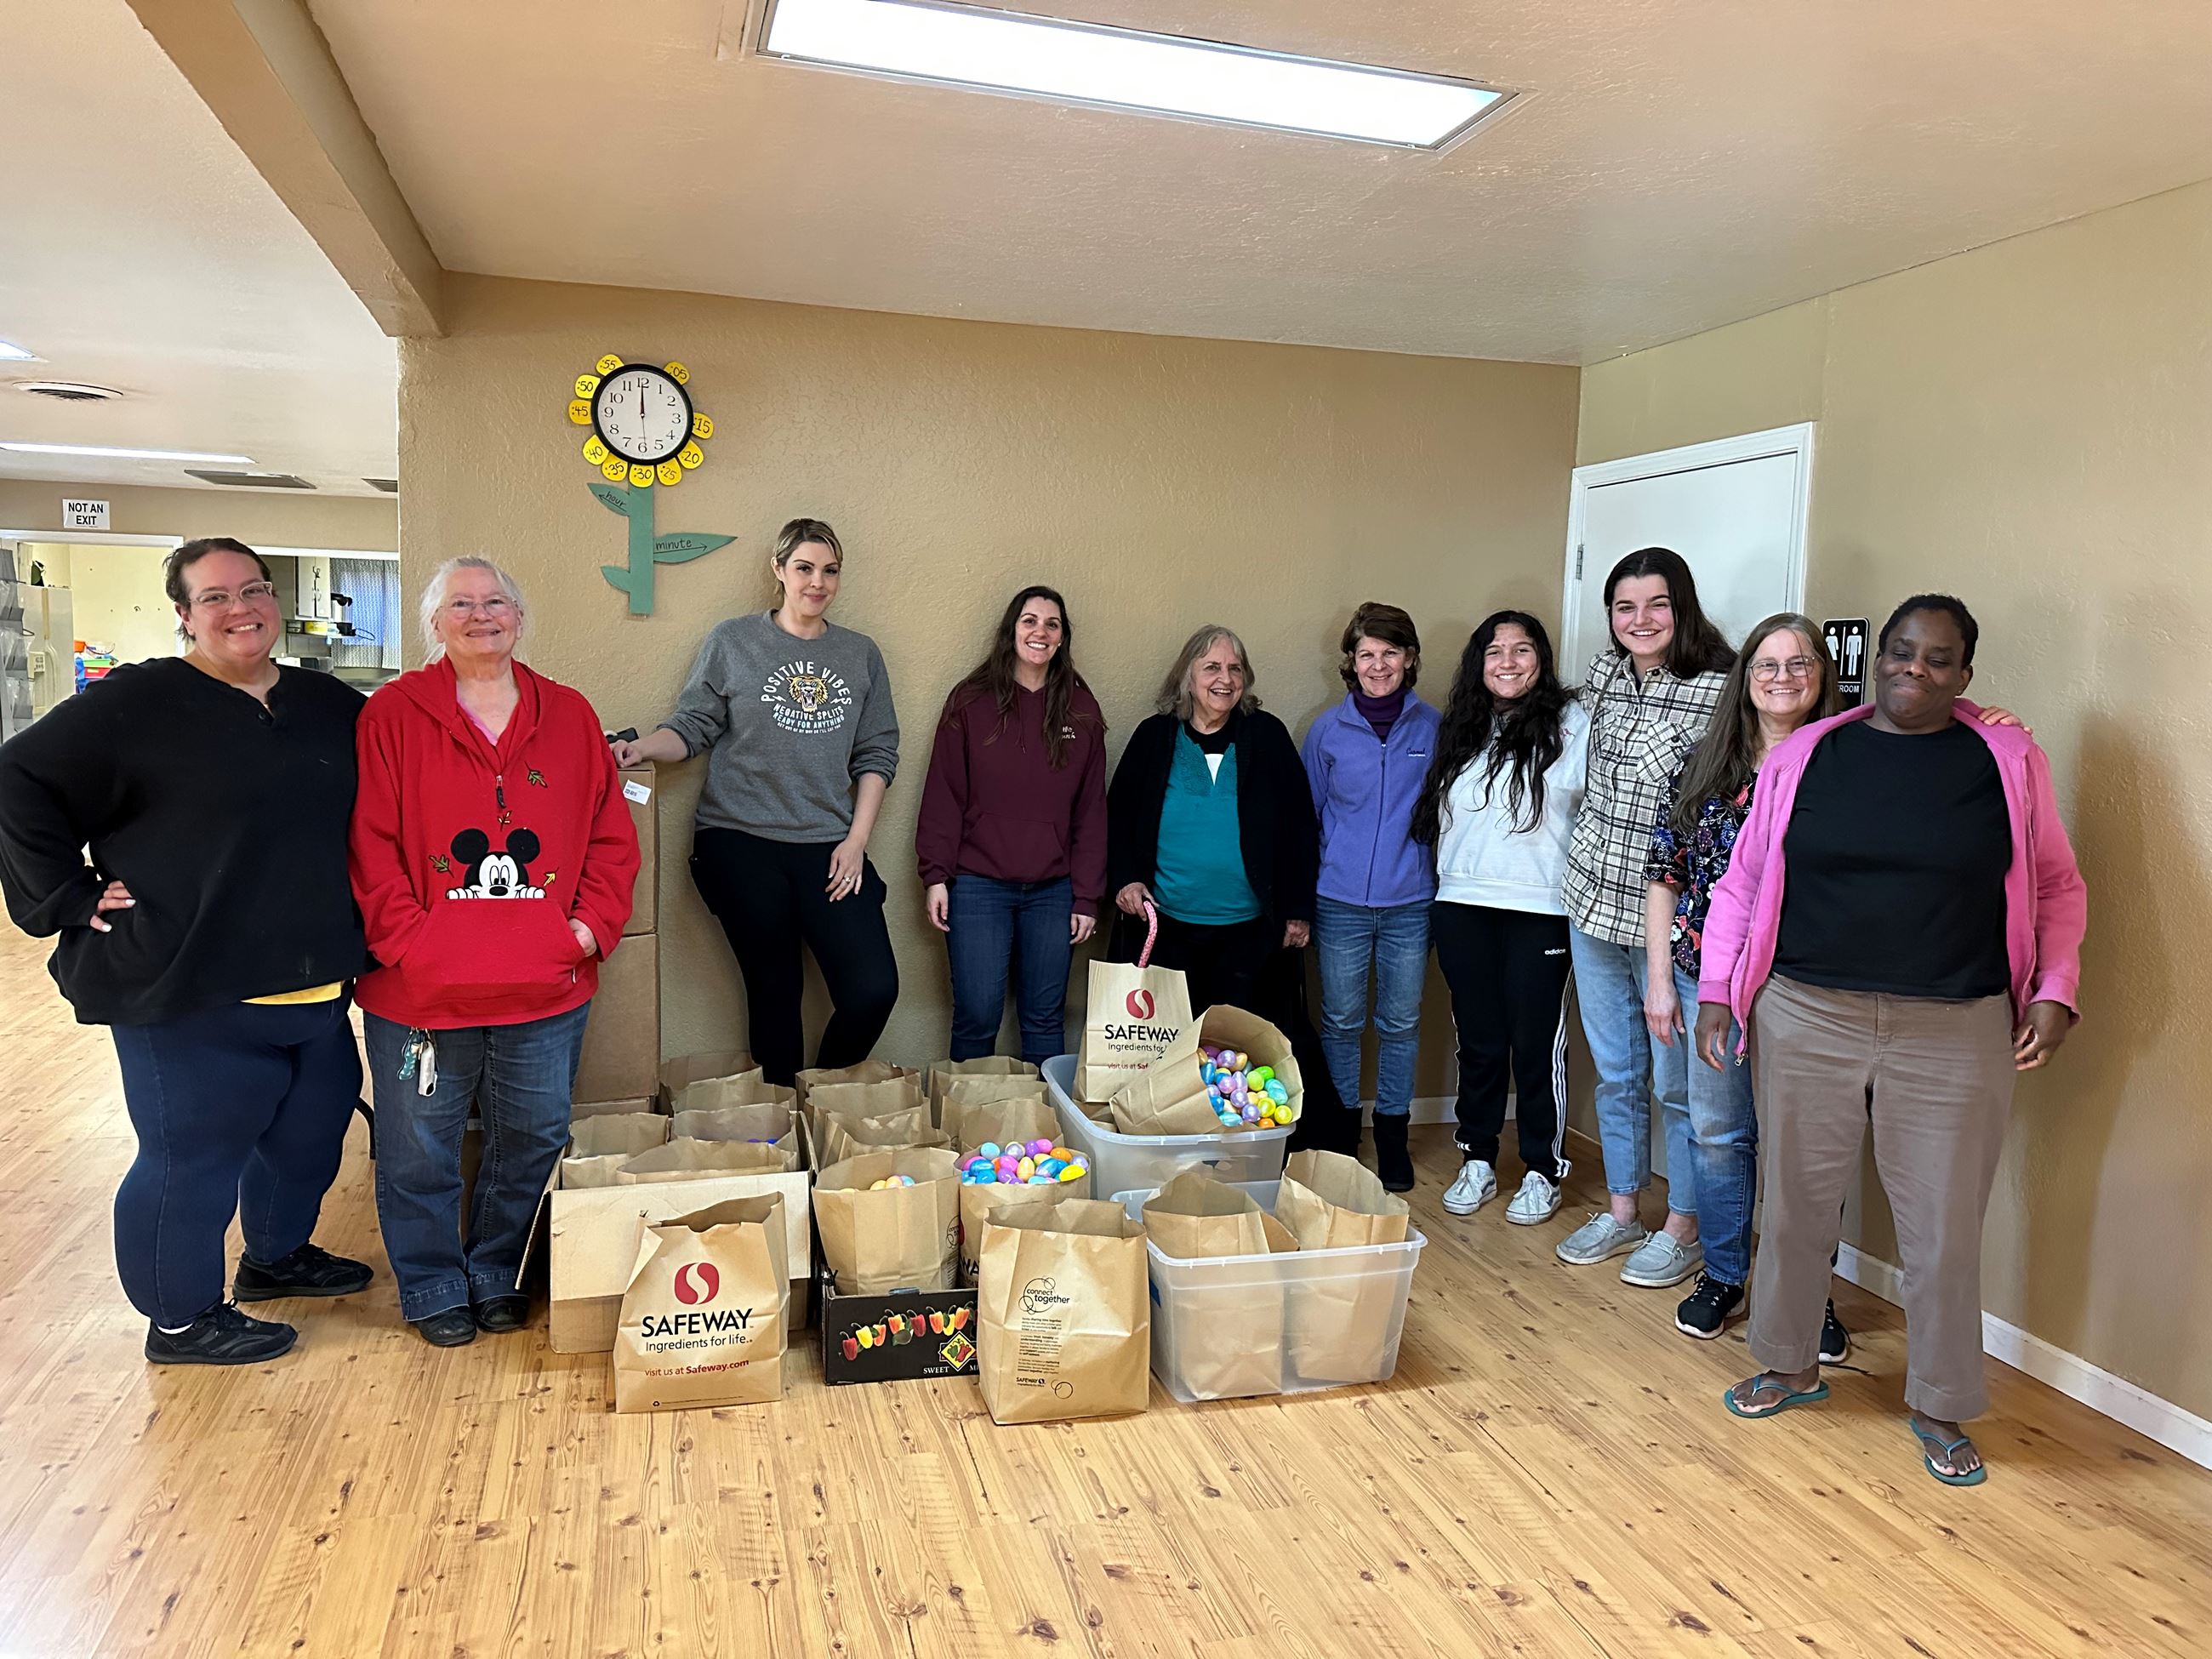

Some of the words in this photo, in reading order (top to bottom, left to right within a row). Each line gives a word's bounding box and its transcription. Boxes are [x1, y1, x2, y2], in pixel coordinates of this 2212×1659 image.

[600, 359, 616, 371] :55
[669, 365, 687, 379] :05
[577, 381, 594, 392] :50
[623, 380, 632, 391] 11
[637, 377, 649, 389] 12
[658, 385, 663, 394] 1
[610, 392, 624, 403] 10
[667, 396, 676, 407] 2
[572, 406, 589, 417] :45
[604, 407, 614, 418] 9
[671, 413, 681, 424] 3
[609, 424, 619, 435] 8
[666, 430, 676, 440] 4
[623, 437, 631, 448] 7
[638, 442, 647, 453] 6
[654, 439, 664, 450] 5
[605, 463, 624, 476] :35
[634, 467, 652, 480] :30
[659, 465, 677, 480] :25
[605, 492, 626, 507] hour
[68, 502, 88, 513] NOT
[90, 503, 104, 513] AN
[76, 515, 97, 525] EXIT
[655, 539, 693, 550] minute
[761, 660, 815, 703] POSITIVE
[821, 667, 852, 706] VIBES
[1838, 684, 1860, 693] ROOM
[772, 703, 814, 721] NEGATIVE
[817, 705, 844, 721] SPLITS
[772, 712, 795, 727] READY
[797, 721, 811, 729] FOR
[813, 714, 845, 729] ANYTHING
[1104, 1024, 1179, 1043] SAFEWAY
[1108, 1043, 1153, 1052] Ingredients
[1035, 1295, 1070, 1304] together
[641, 1308, 753, 1337] SAFEWAY
[646, 1338, 708, 1354] Ingredients
[710, 1336, 727, 1347] for
[645, 1367, 662, 1377] visit
[686, 1360, 750, 1375] Safeway.com
[923, 1366, 949, 1375] SWEET
